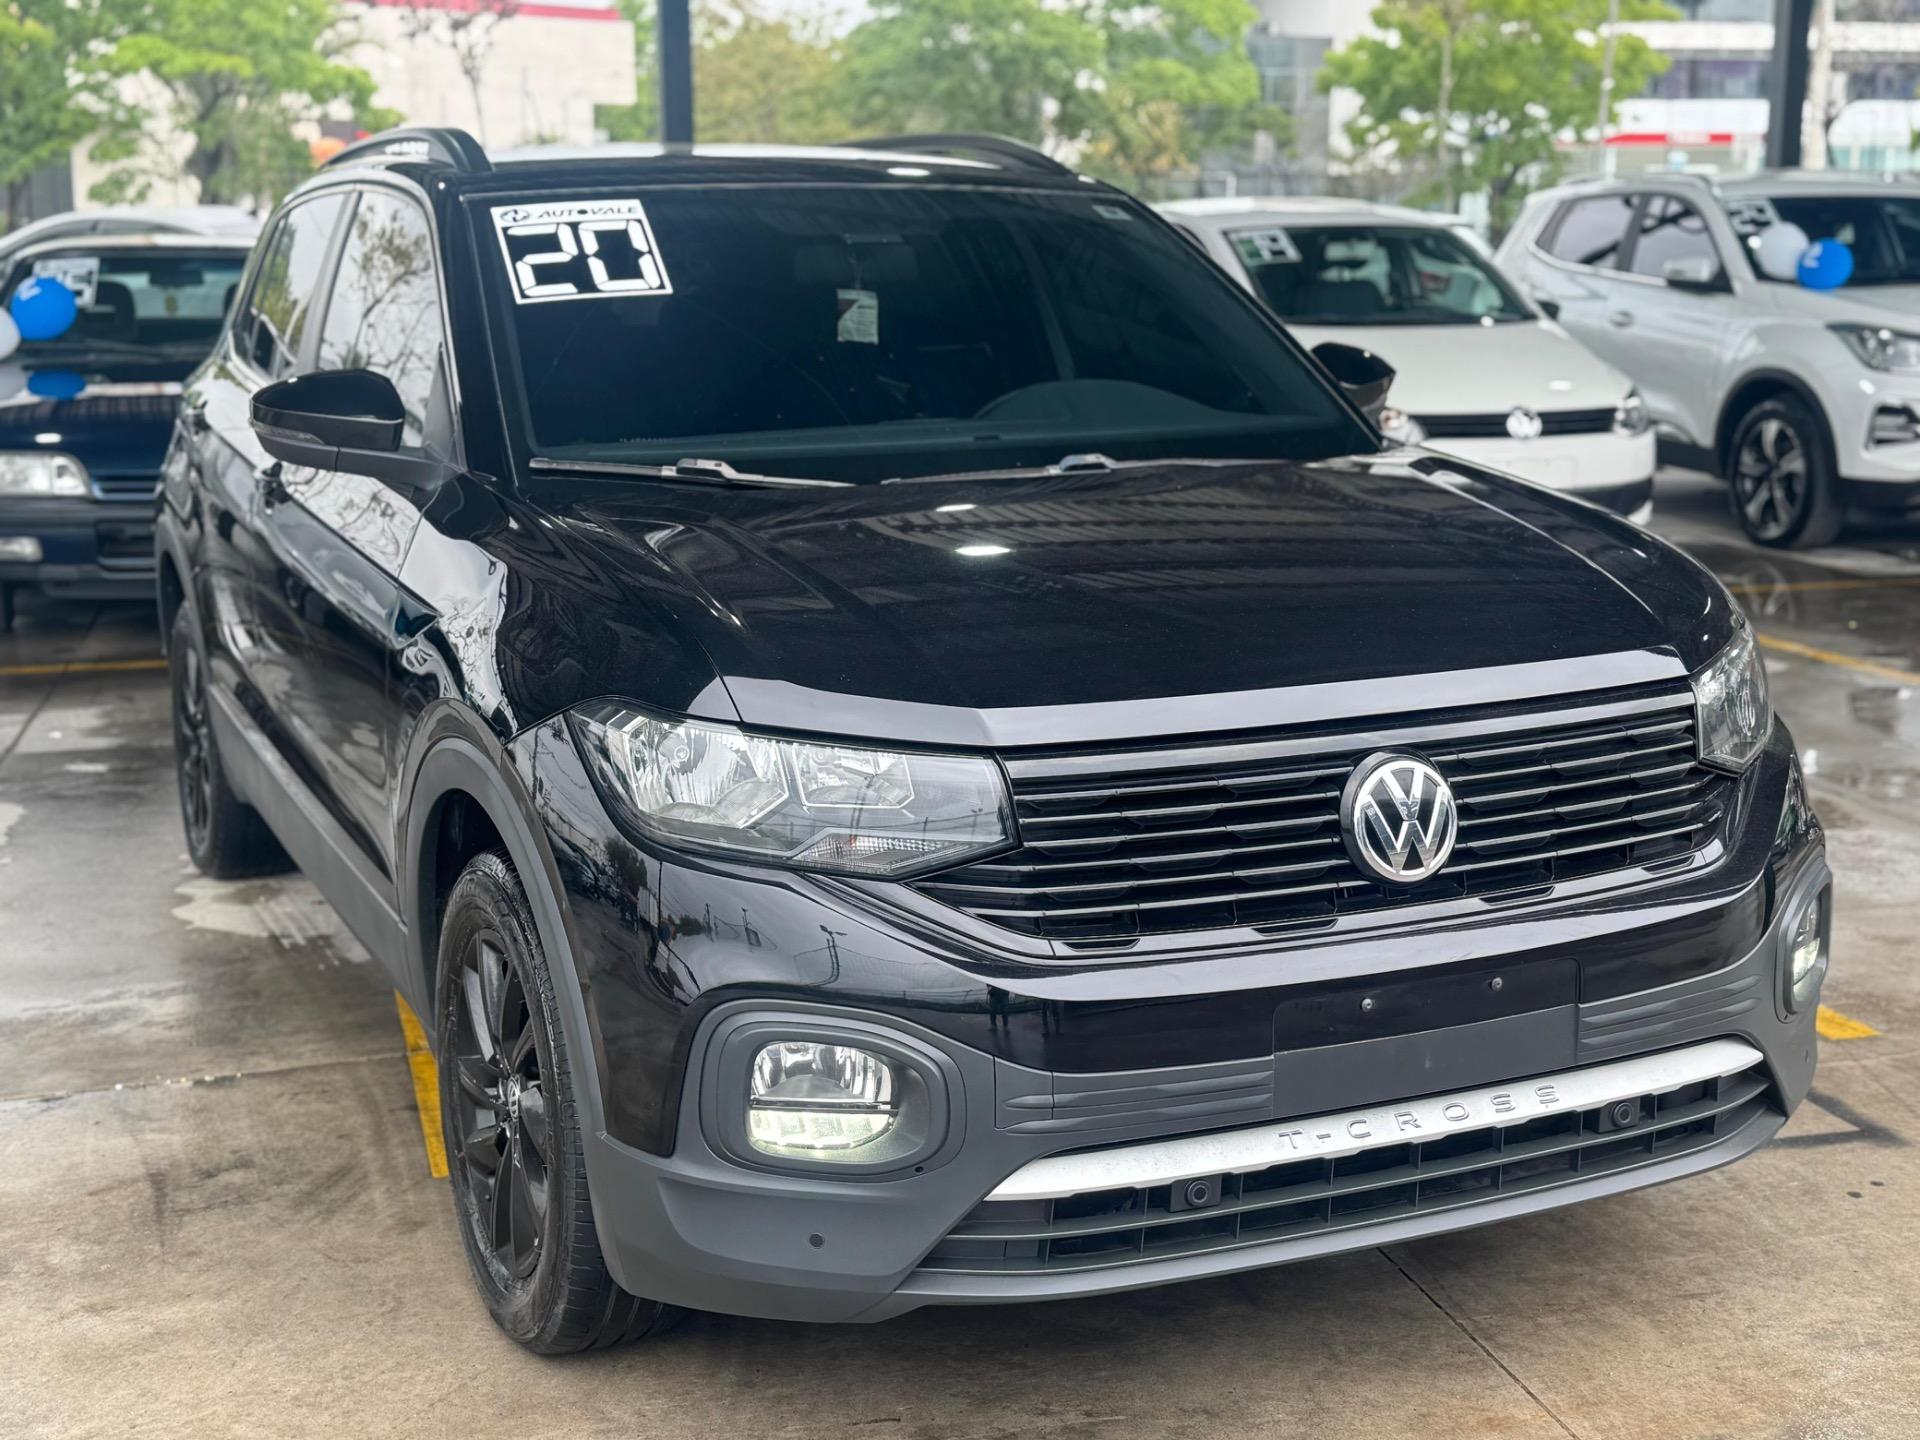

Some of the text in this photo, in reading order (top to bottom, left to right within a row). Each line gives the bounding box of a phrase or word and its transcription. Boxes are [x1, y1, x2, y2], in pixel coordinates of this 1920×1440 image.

[506, 220, 661, 297] 20
[1355, 760, 1457, 881] VW
[1278, 1083, 1560, 1150] T-CROSS
